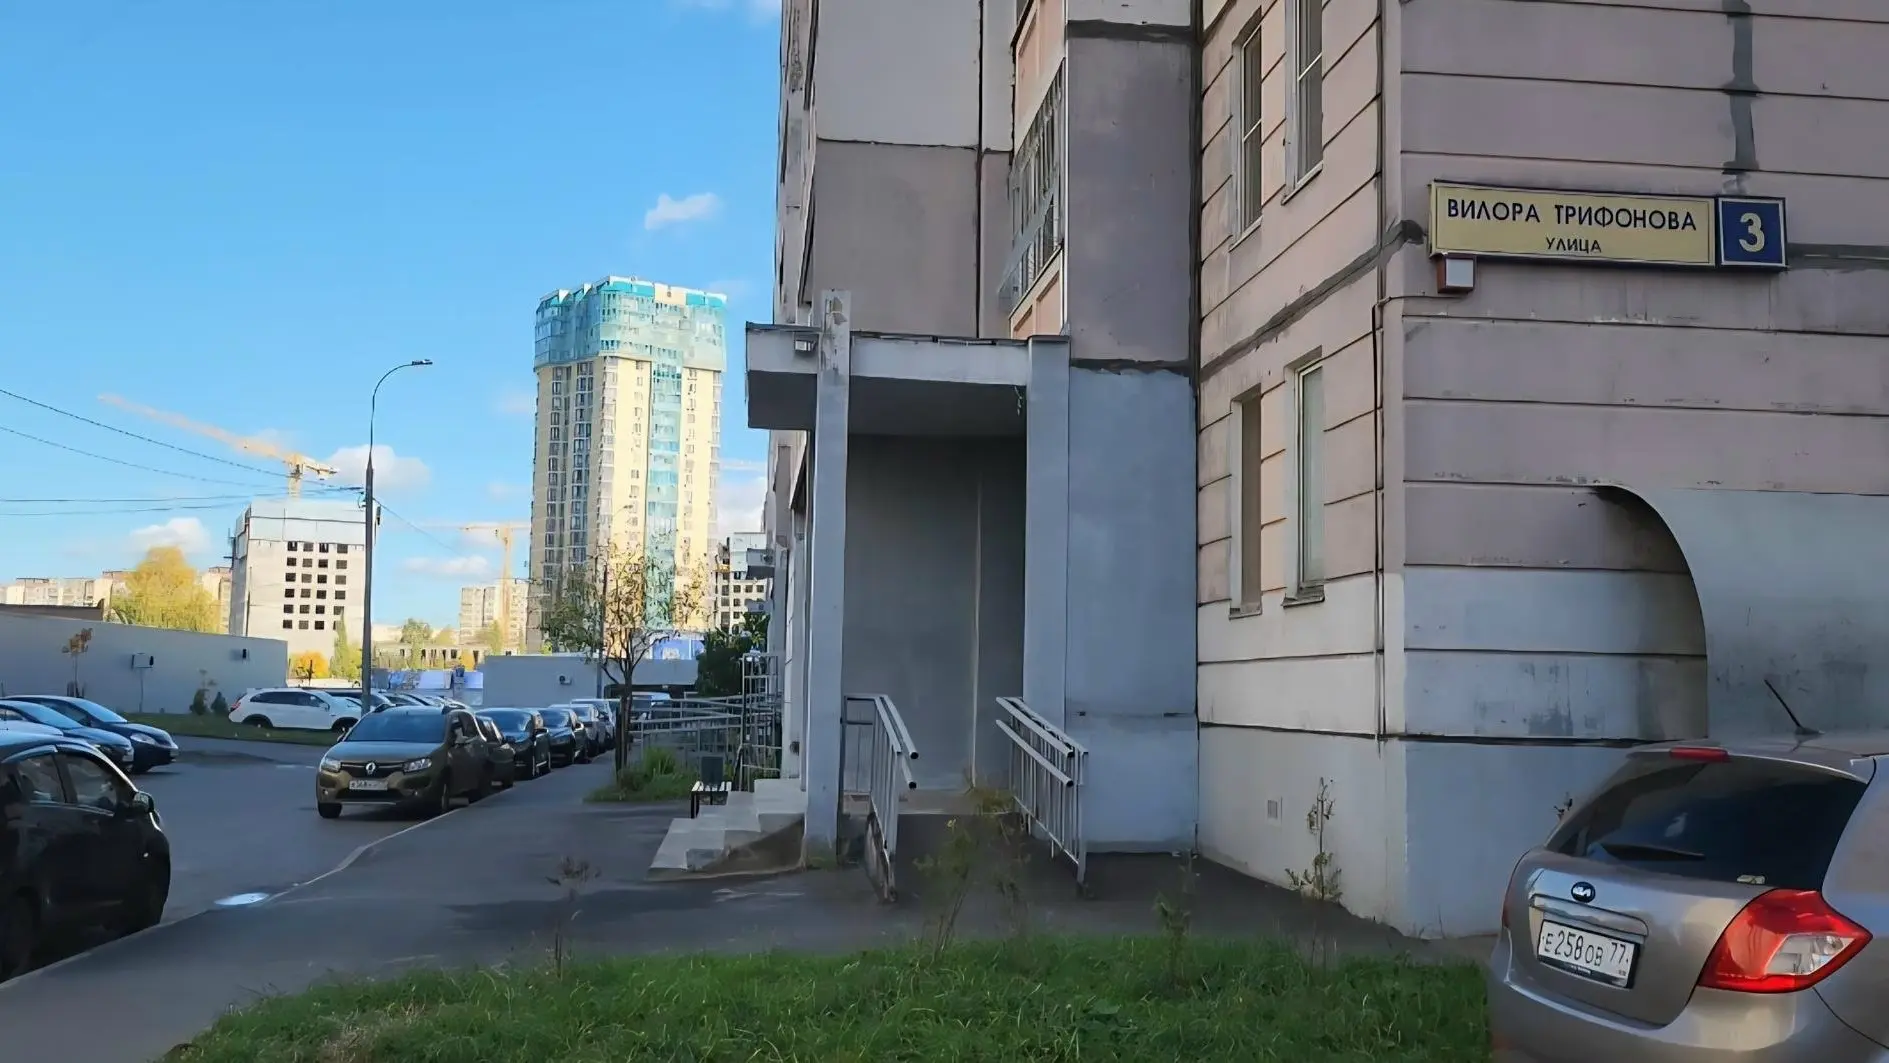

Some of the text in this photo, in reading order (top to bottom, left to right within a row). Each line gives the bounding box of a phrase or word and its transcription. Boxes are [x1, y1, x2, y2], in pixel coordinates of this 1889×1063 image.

[1447, 198, 1697, 231] ВИЛОРА ТРИФОНОВА
[1545, 236, 1602, 254] УЛИЦА
[1738, 212, 1766, 253] 3
